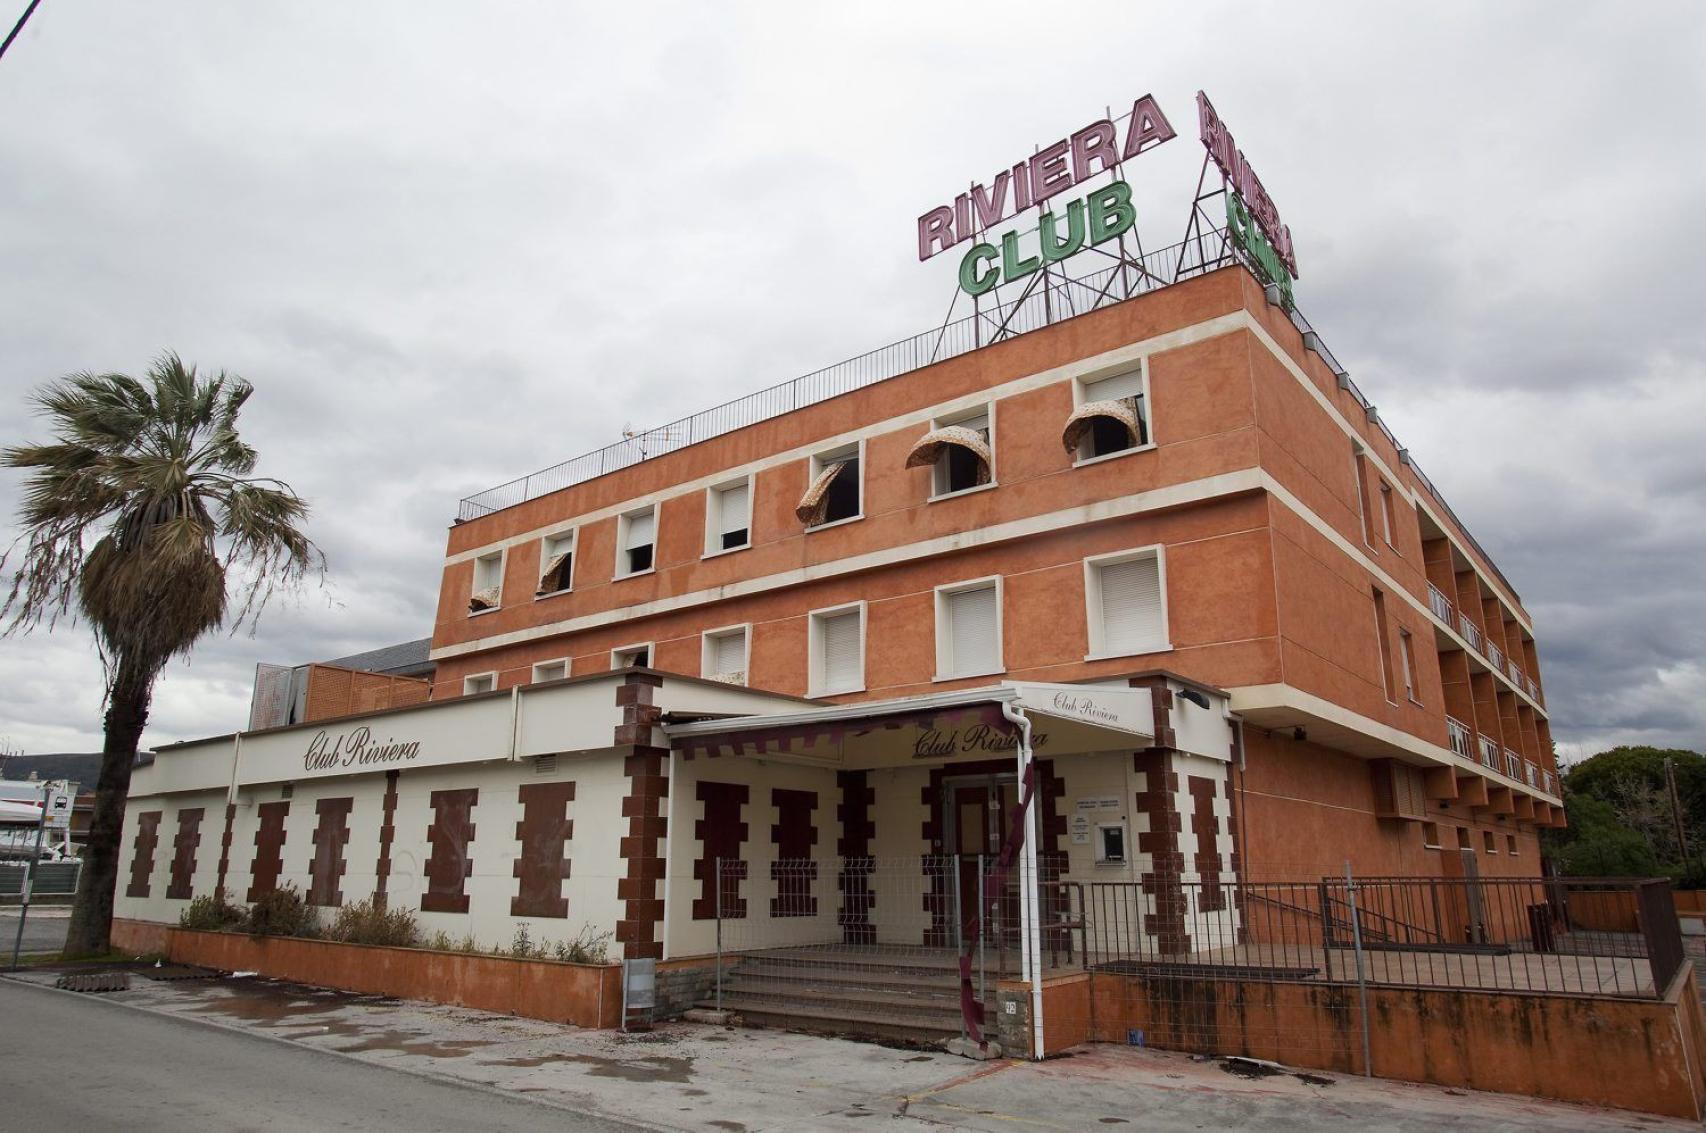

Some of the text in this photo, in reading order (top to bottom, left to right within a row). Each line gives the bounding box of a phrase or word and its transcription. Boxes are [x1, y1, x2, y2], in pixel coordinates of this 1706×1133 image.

[918, 93, 1178, 262] RIVIERA
[958, 180, 1137, 297] CLUB
[1053, 690, 1077, 711] Club
[304, 726, 421, 771] Club Riviera
[914, 729, 958, 756] Club
